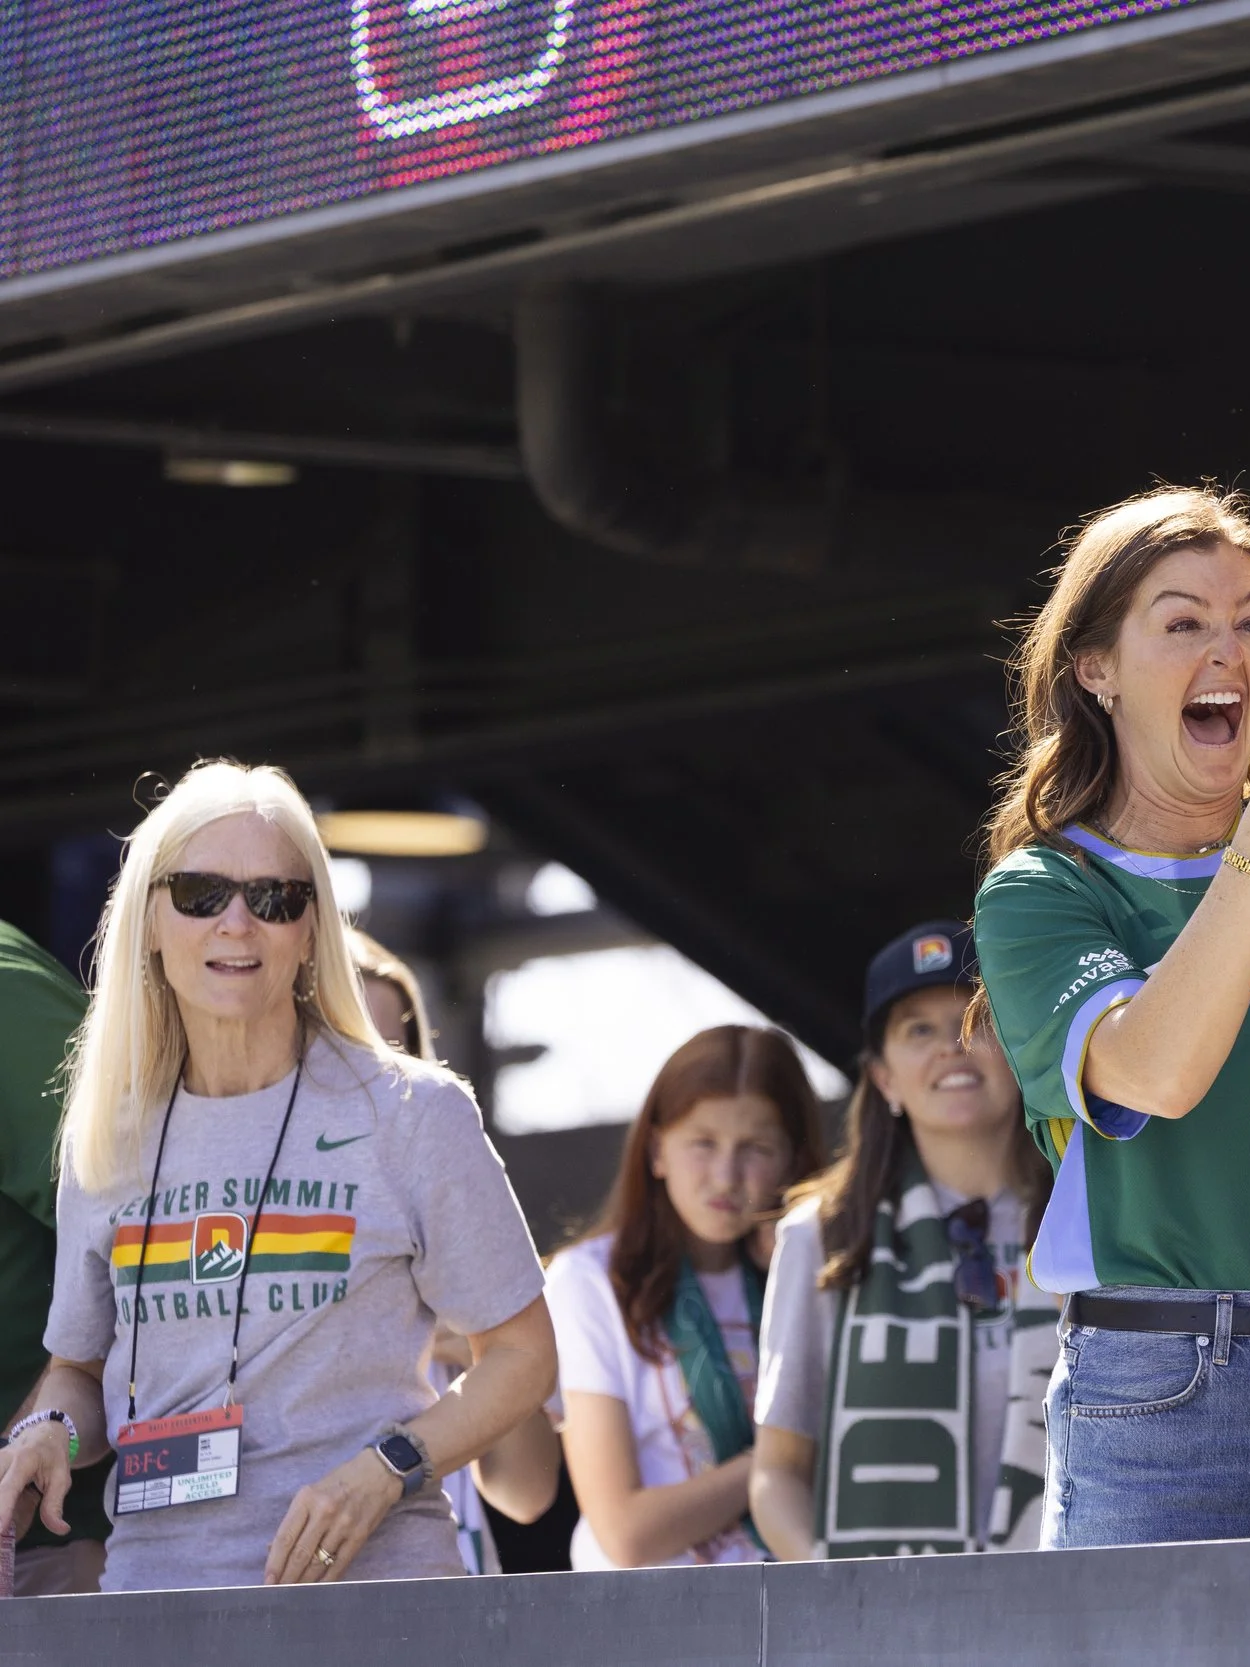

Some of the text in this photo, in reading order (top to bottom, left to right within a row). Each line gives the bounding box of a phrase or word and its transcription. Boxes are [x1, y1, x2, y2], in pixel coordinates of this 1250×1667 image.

[222, 1177, 358, 1212] SUMMIT
[117, 1277, 349, 1326] OOTBALL CLUB
[177, 1470, 232, 1487] UNLIMITED
[190, 1481, 218, 1493] FIELD
[185, 1487, 223, 1501] ACCESS
